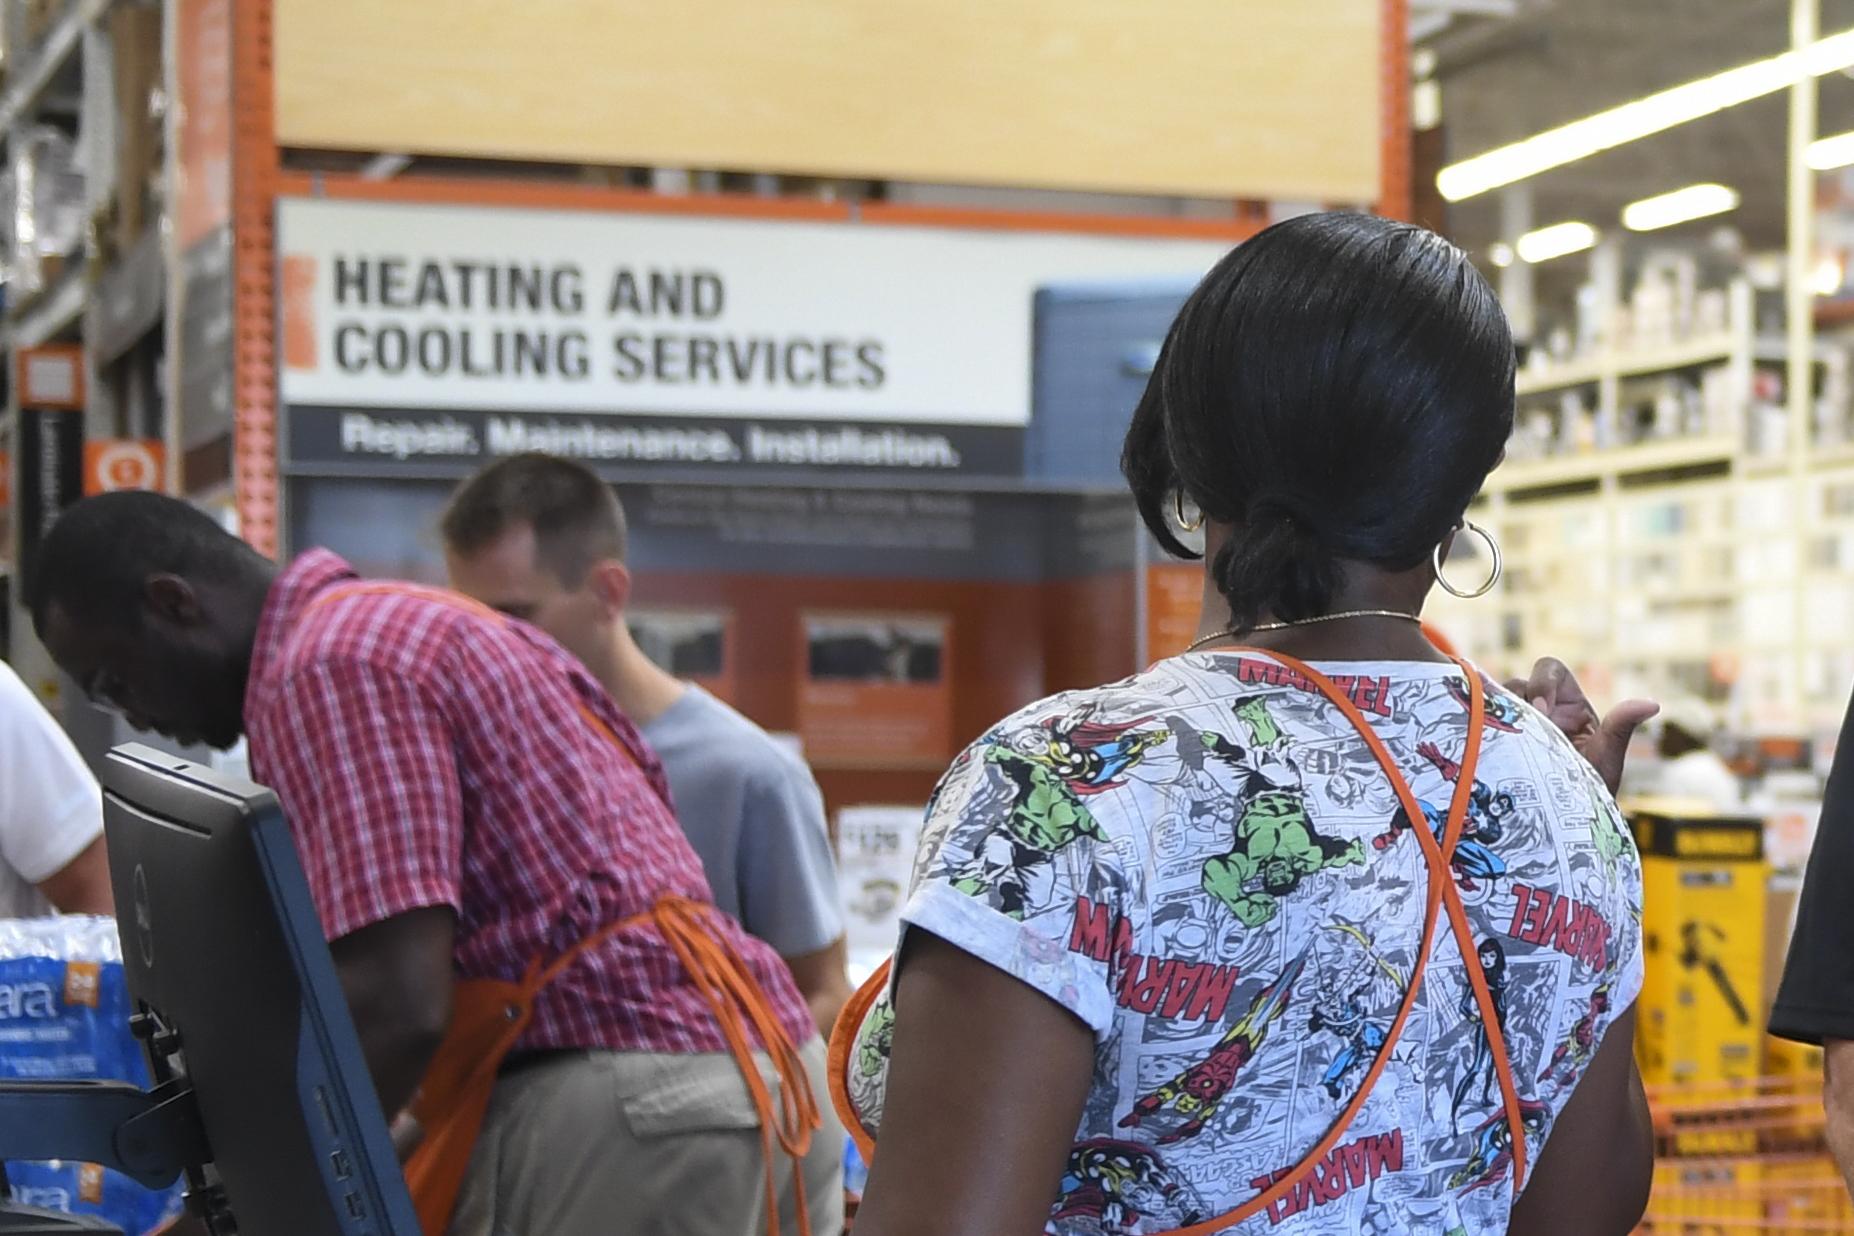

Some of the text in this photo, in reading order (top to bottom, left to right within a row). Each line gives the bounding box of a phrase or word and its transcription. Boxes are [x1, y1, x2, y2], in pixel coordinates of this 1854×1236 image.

[334, 259, 724, 319] HEATING AND
[335, 323, 886, 389] COOLING SERVICES
[341, 412, 962, 468] Repair. Maintenance. Installation.
